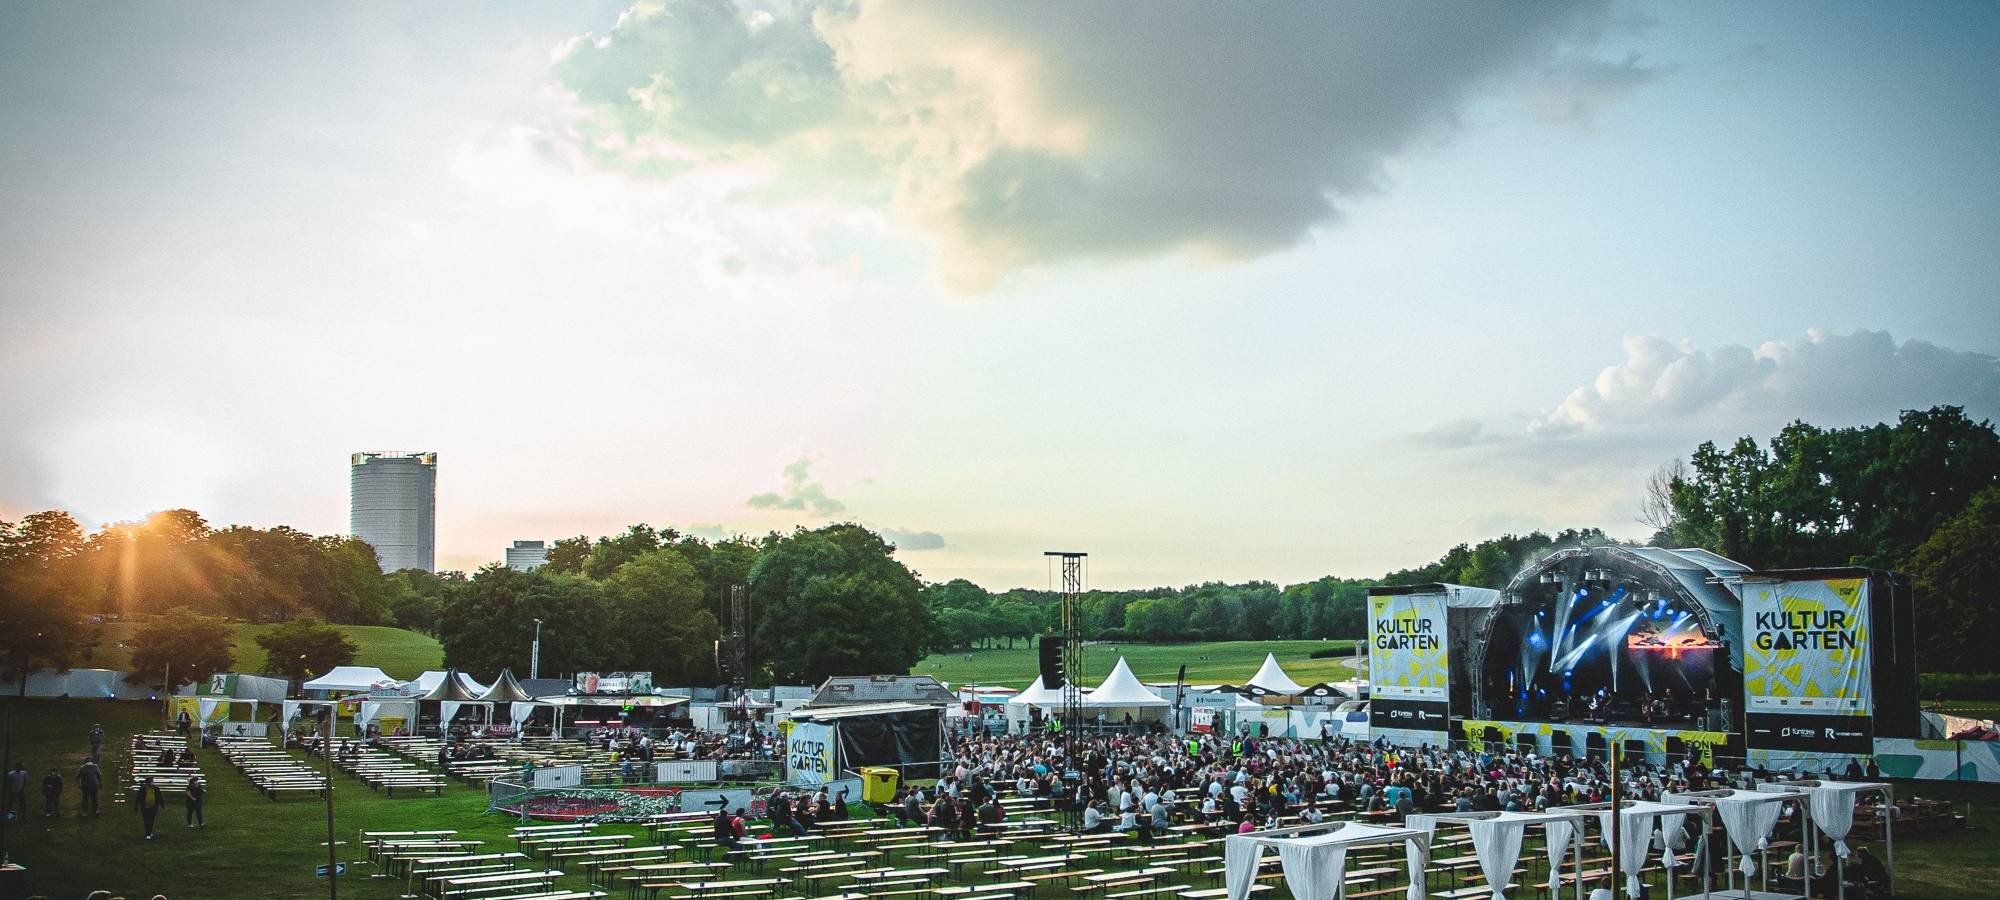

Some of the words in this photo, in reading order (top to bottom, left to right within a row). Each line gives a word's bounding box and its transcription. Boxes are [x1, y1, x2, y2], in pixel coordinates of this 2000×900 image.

[1376, 619, 1432, 634] KULTUR
[1756, 610, 1846, 629] KULTUR
[1376, 635, 1439, 650] GARTEN
[1755, 630, 1856, 650] GARTEN
[792, 739, 824, 757] KULTUR
[791, 755, 827, 774] GARTEN
